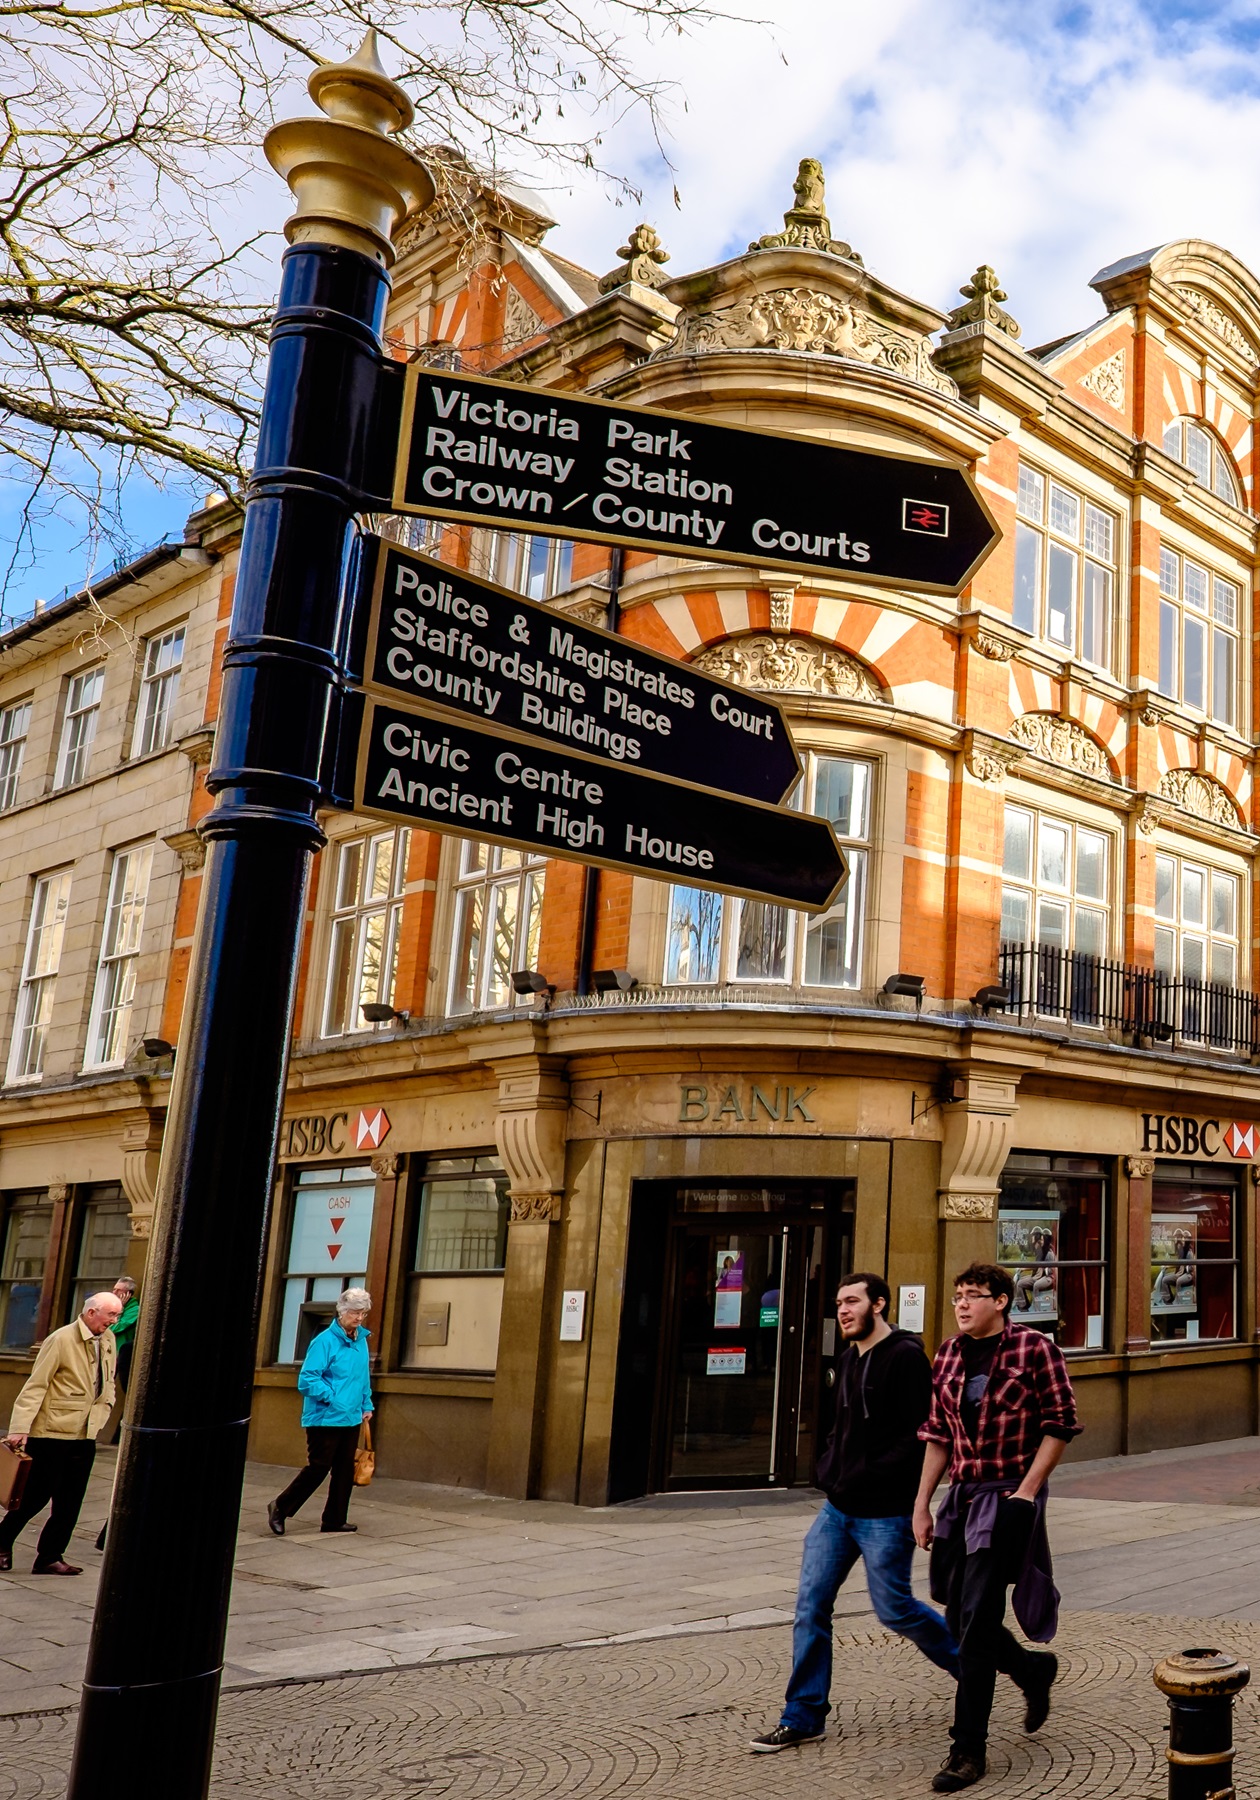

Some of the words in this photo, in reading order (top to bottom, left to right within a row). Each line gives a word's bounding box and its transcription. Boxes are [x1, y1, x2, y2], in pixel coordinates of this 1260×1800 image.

[431, 386, 580, 442] Victoria
[607, 419, 693, 461] Park
[426, 426, 575, 482] Railway
[603, 457, 734, 505] Station
[751, 518, 872, 563] Courts
[390, 608, 586, 704] Staffordshire
[603, 686, 672, 736] Place
[394, 564, 489, 628] Police
[507, 613, 532, 647] &
[548, 629, 696, 709] Magistrates
[709, 692, 775, 741] Court
[386, 646, 502, 715] County
[520, 692, 642, 760] Buildings
[382, 722, 470, 772] Civic
[495, 752, 604, 805] Centre
[377, 768, 514, 826] Ancient
[535, 803, 605, 847] High
[624, 826, 715, 870] House
[678, 1084, 818, 1123] BANK
[1140, 1113, 1221, 1157] HSBC
[328, 1196, 351, 1210] CASH
[693, 1192, 737, 1201] Welcome
